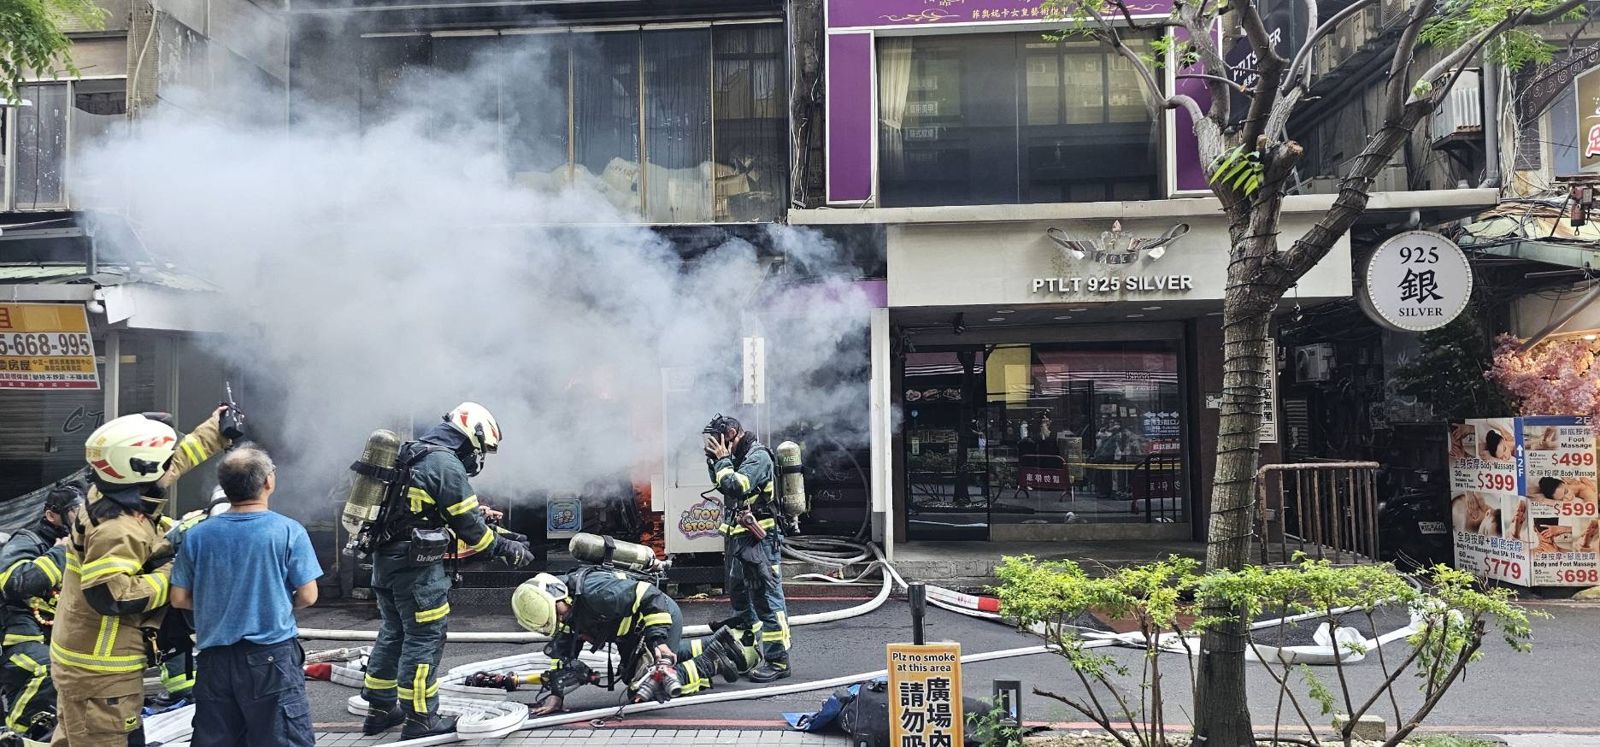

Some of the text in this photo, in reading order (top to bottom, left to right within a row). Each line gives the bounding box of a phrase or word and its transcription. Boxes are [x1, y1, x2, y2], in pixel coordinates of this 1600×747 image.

[1400, 247, 1439, 264] 925
[1033, 274, 1194, 292] PTLT 925 SILVER
[1397, 267, 1444, 304] 銀
[1399, 307, 1443, 316] SILVER
[0, 333, 90, 355] 5-668-995
[1453, 457, 1515, 472] 上身按摩 Body Massage
[1551, 452, 1594, 466] $499
[1517, 459, 1524, 477] 2F
[1529, 469, 1596, 478] 全身按摩 Body Massage
[1478, 470, 1515, 491] $399
[693, 508, 720, 521] TOY
[1553, 502, 1596, 516] $599
[684, 520, 720, 532] STORY
[1484, 553, 1522, 579] $779
[1556, 569, 1598, 583] $698
[892, 653, 906, 661] Plz
[924, 652, 955, 662] smoke
[909, 663, 927, 672] this
[926, 677, 951, 747] 廣場內
